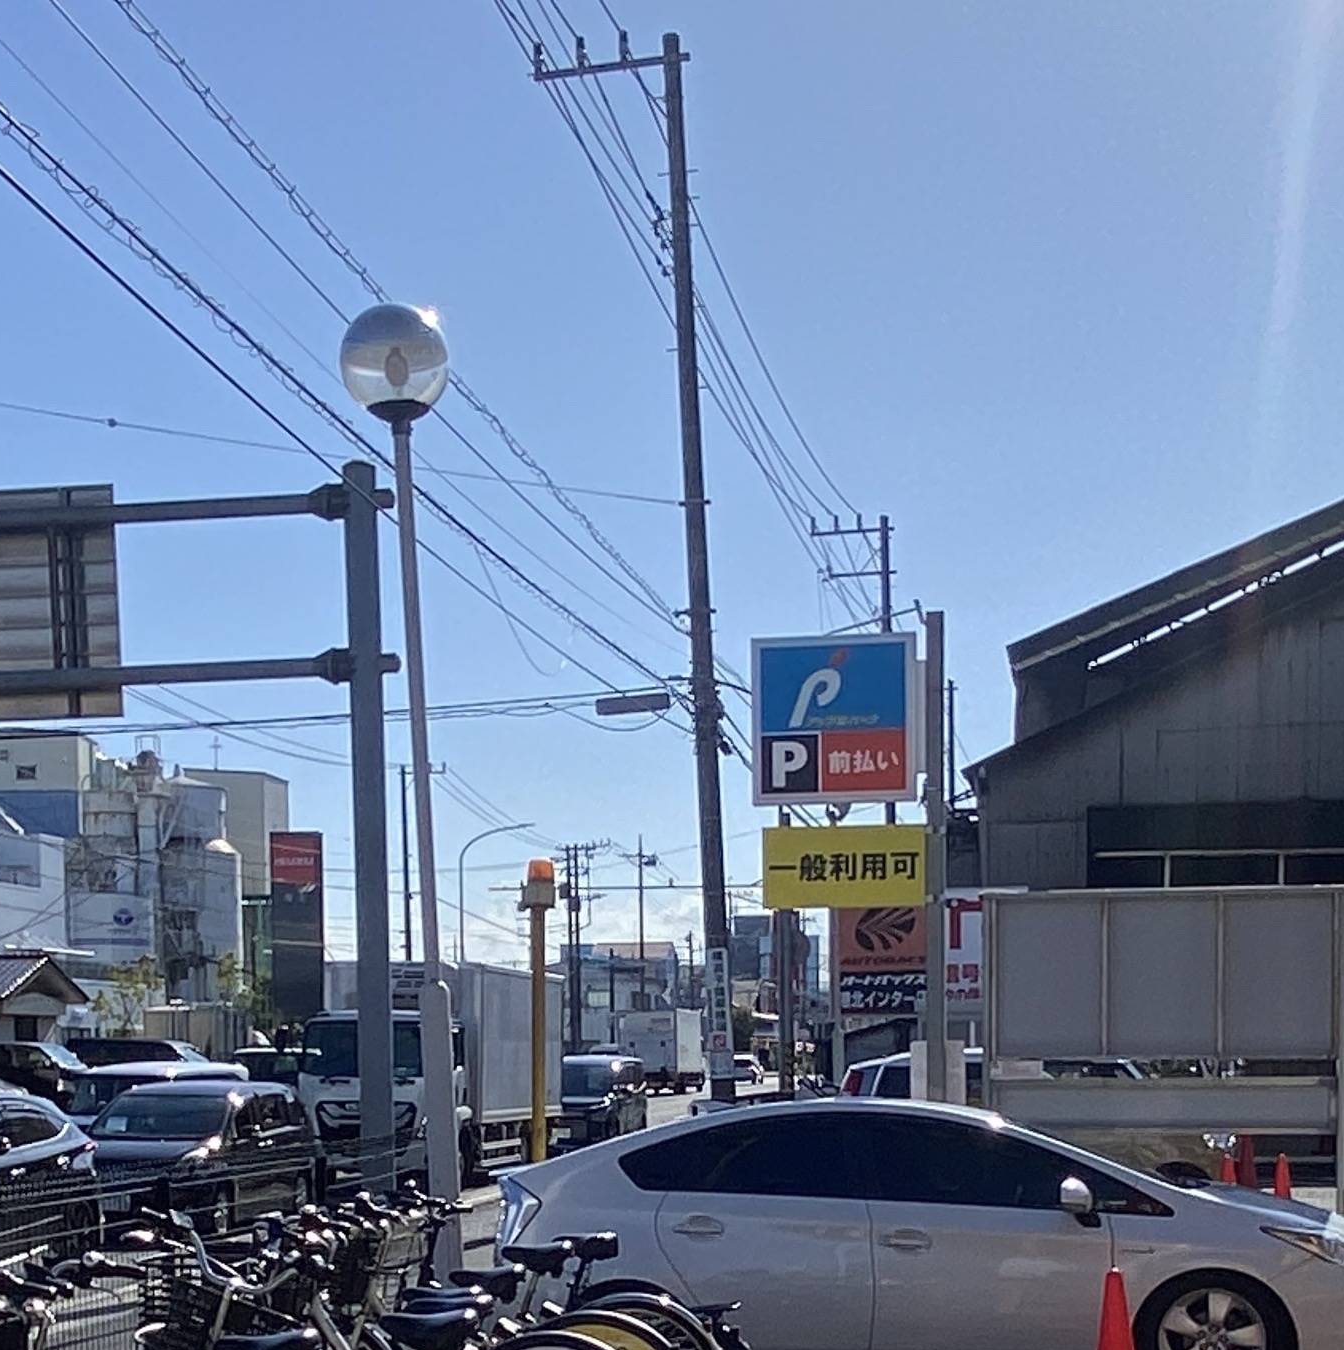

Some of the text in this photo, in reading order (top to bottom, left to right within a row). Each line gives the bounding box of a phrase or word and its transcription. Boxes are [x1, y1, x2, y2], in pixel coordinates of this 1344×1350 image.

[770, 740, 808, 788] P
[828, 749, 899, 774] 前払い
[768, 851, 919, 882] 一般利用可
